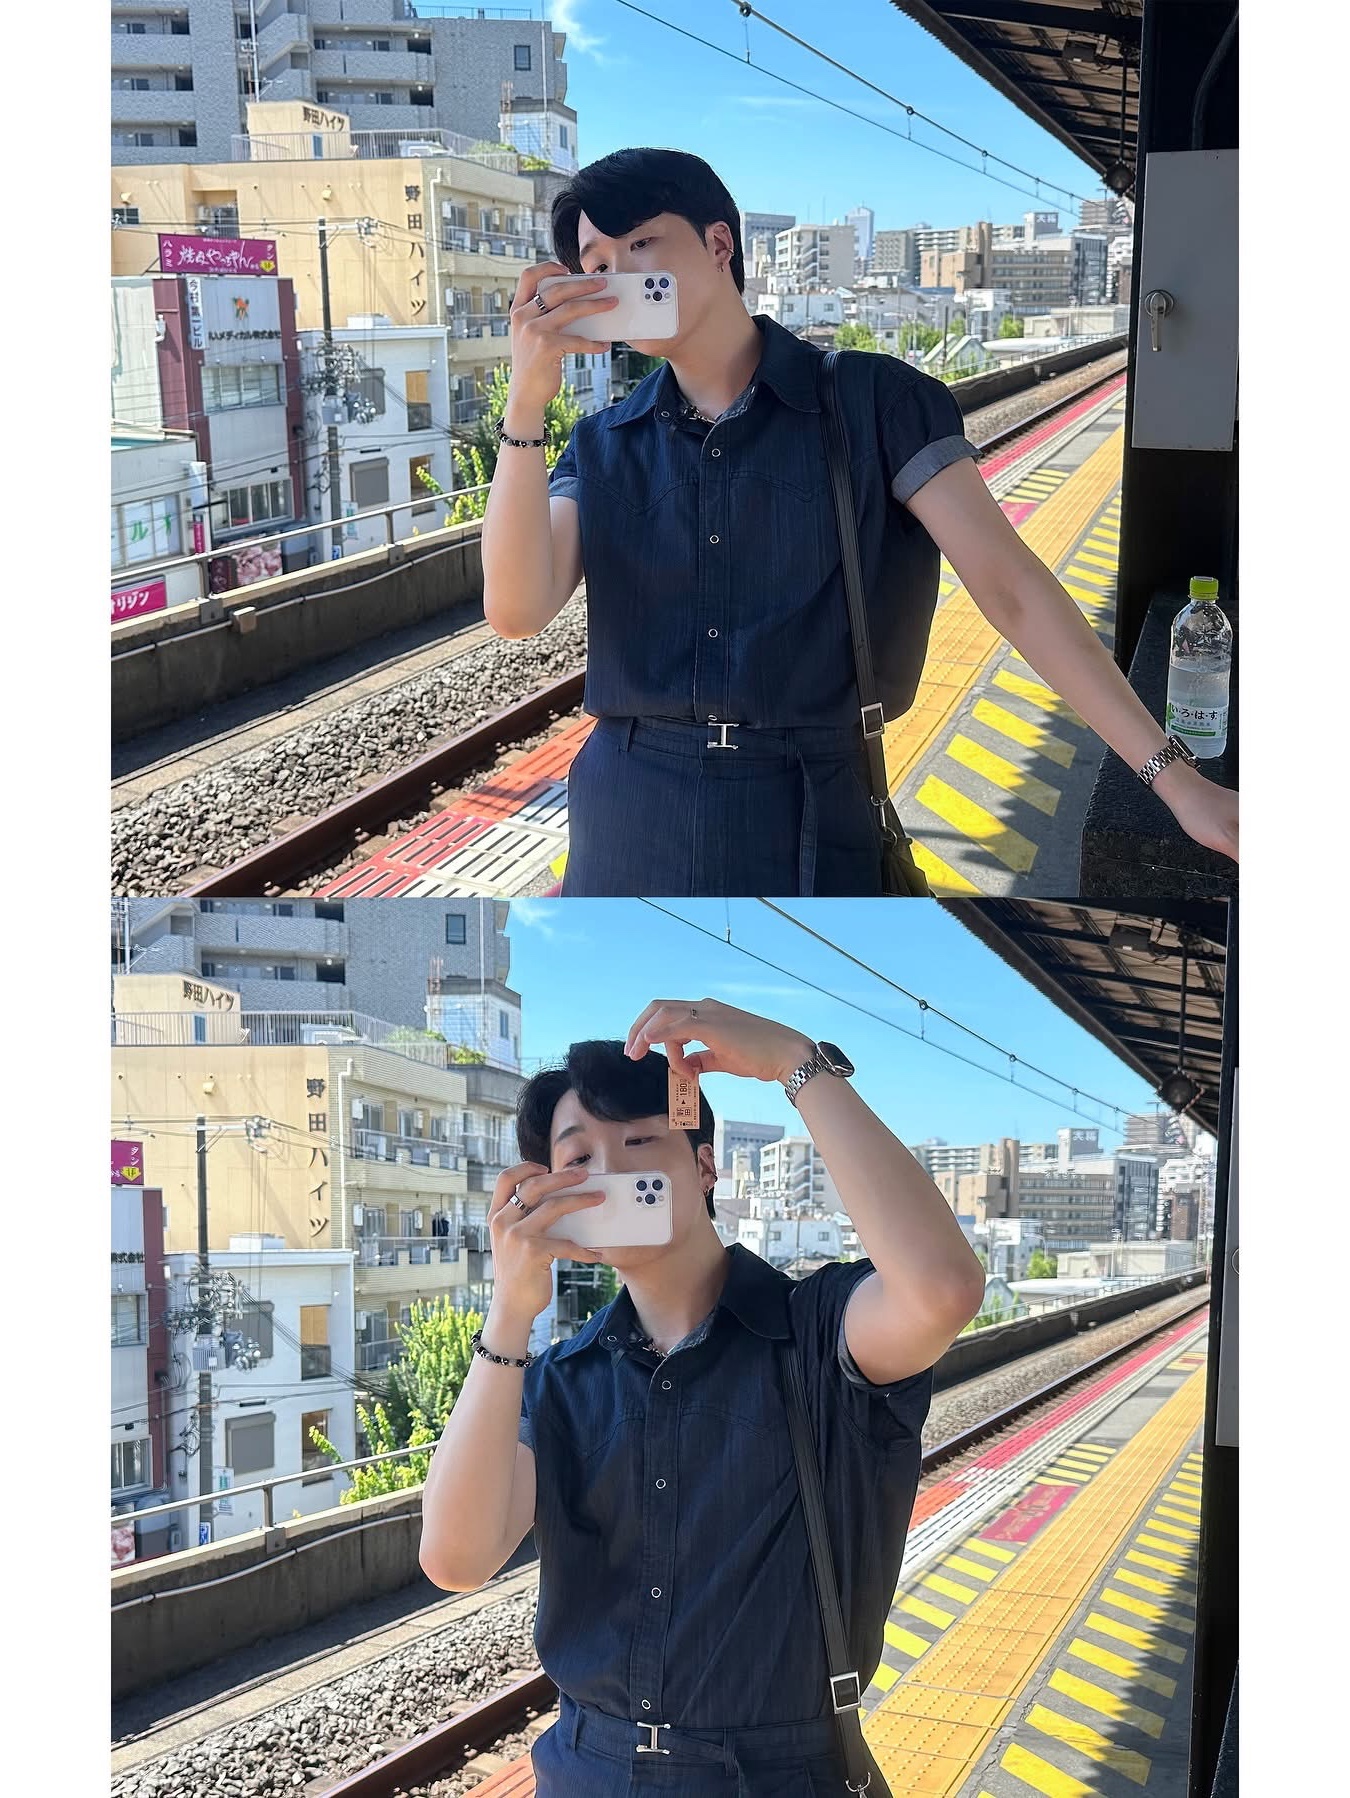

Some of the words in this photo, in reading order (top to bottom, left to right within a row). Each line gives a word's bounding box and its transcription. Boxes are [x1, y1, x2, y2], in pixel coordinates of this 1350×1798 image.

[303, 106, 345, 131] 野田ハイツ
[404, 185, 427, 316] 野田ハイツ
[182, 980, 235, 1013] 野田ハイツ
[306, 1078, 329, 1239] 野田ハイツ
